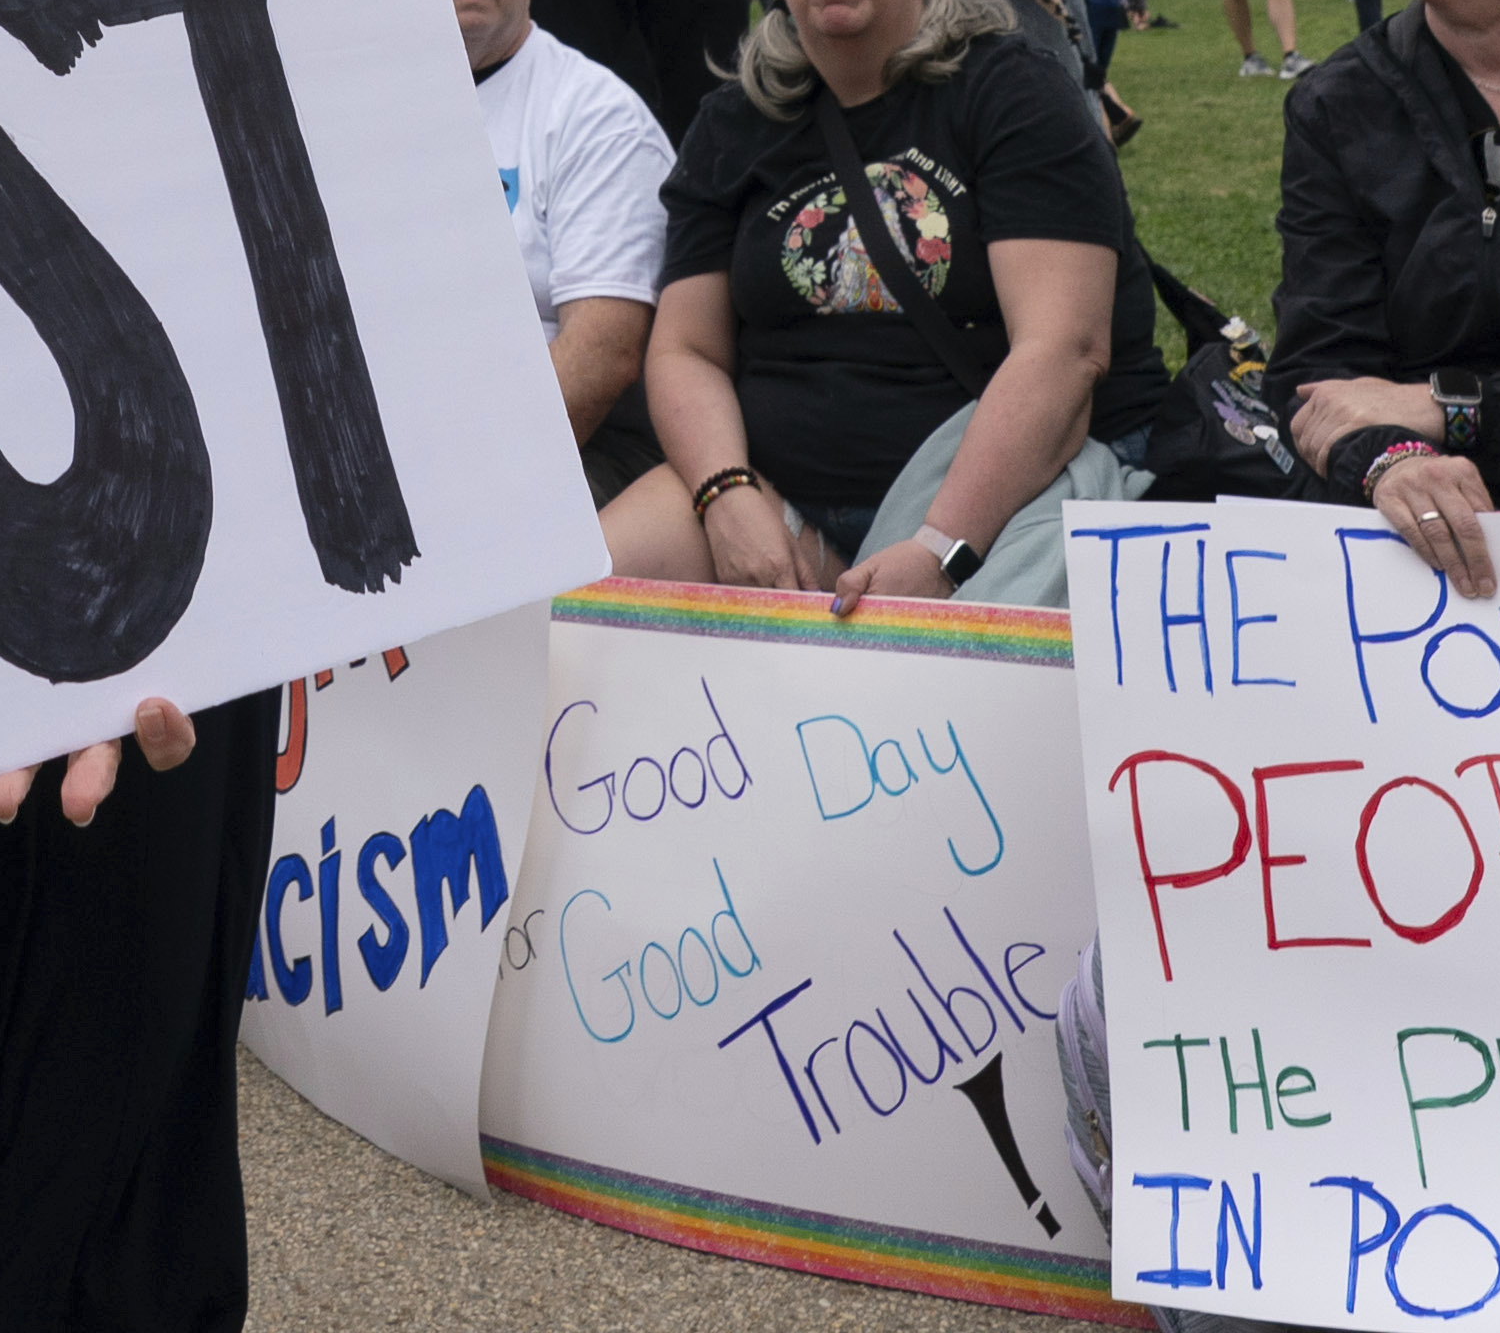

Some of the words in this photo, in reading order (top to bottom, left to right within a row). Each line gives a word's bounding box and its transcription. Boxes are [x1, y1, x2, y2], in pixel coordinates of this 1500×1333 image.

[1071, 523, 1296, 696] THE
[544, 676, 753, 835] Good
[795, 714, 1005, 876] Day
[559, 857, 763, 1045] Good
[1132, 1172, 1265, 1291] IN
